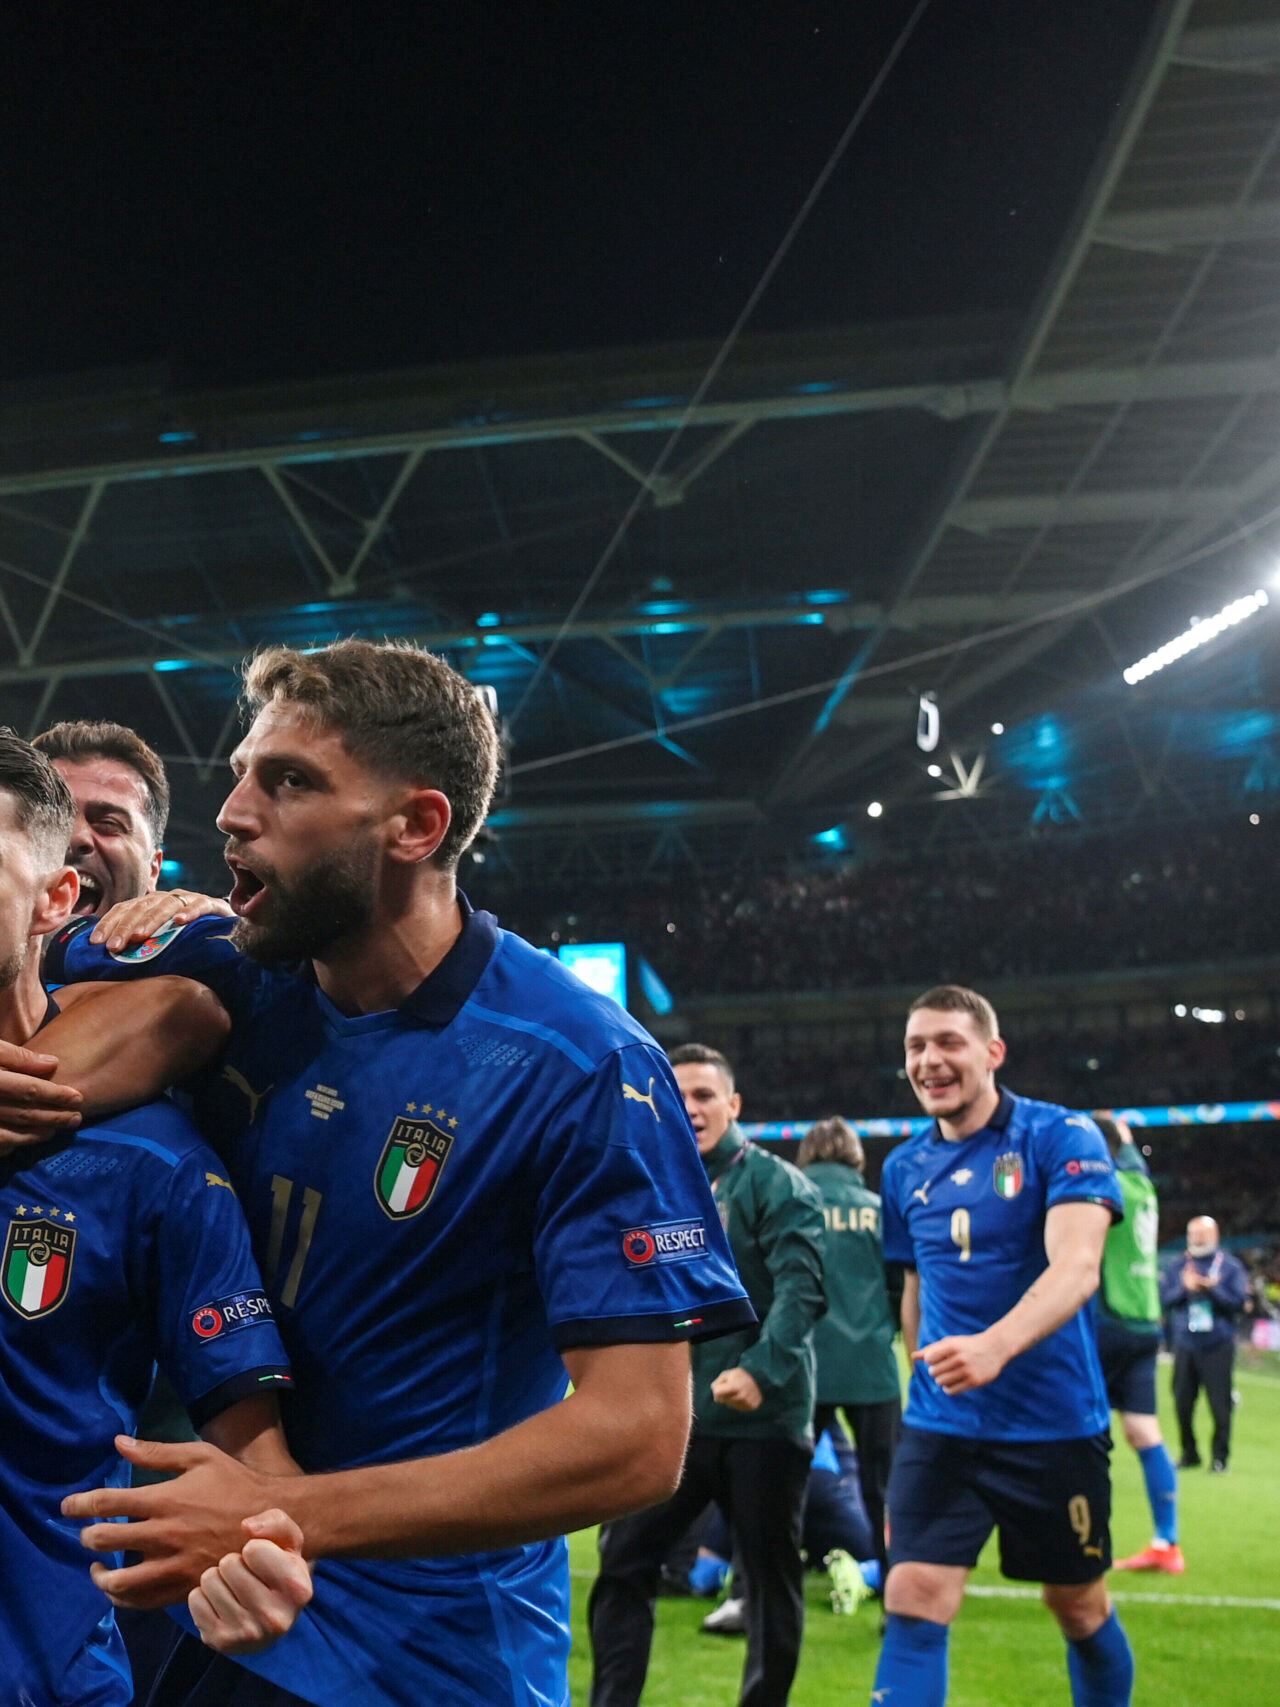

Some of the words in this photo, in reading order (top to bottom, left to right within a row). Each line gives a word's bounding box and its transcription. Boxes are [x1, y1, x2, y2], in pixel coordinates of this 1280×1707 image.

[397, 1124, 446, 1153] ITALIA
[14, 1227, 69, 1248] ITALIA
[267, 1174, 322, 1309] 11
[655, 1228, 705, 1252] RESPECT
[951, 1208, 970, 1262] 9
[195, 1309, 213, 1320] UEFA
[223, 1298, 272, 1322] RESPE
[1067, 1494, 1091, 1545] 9
